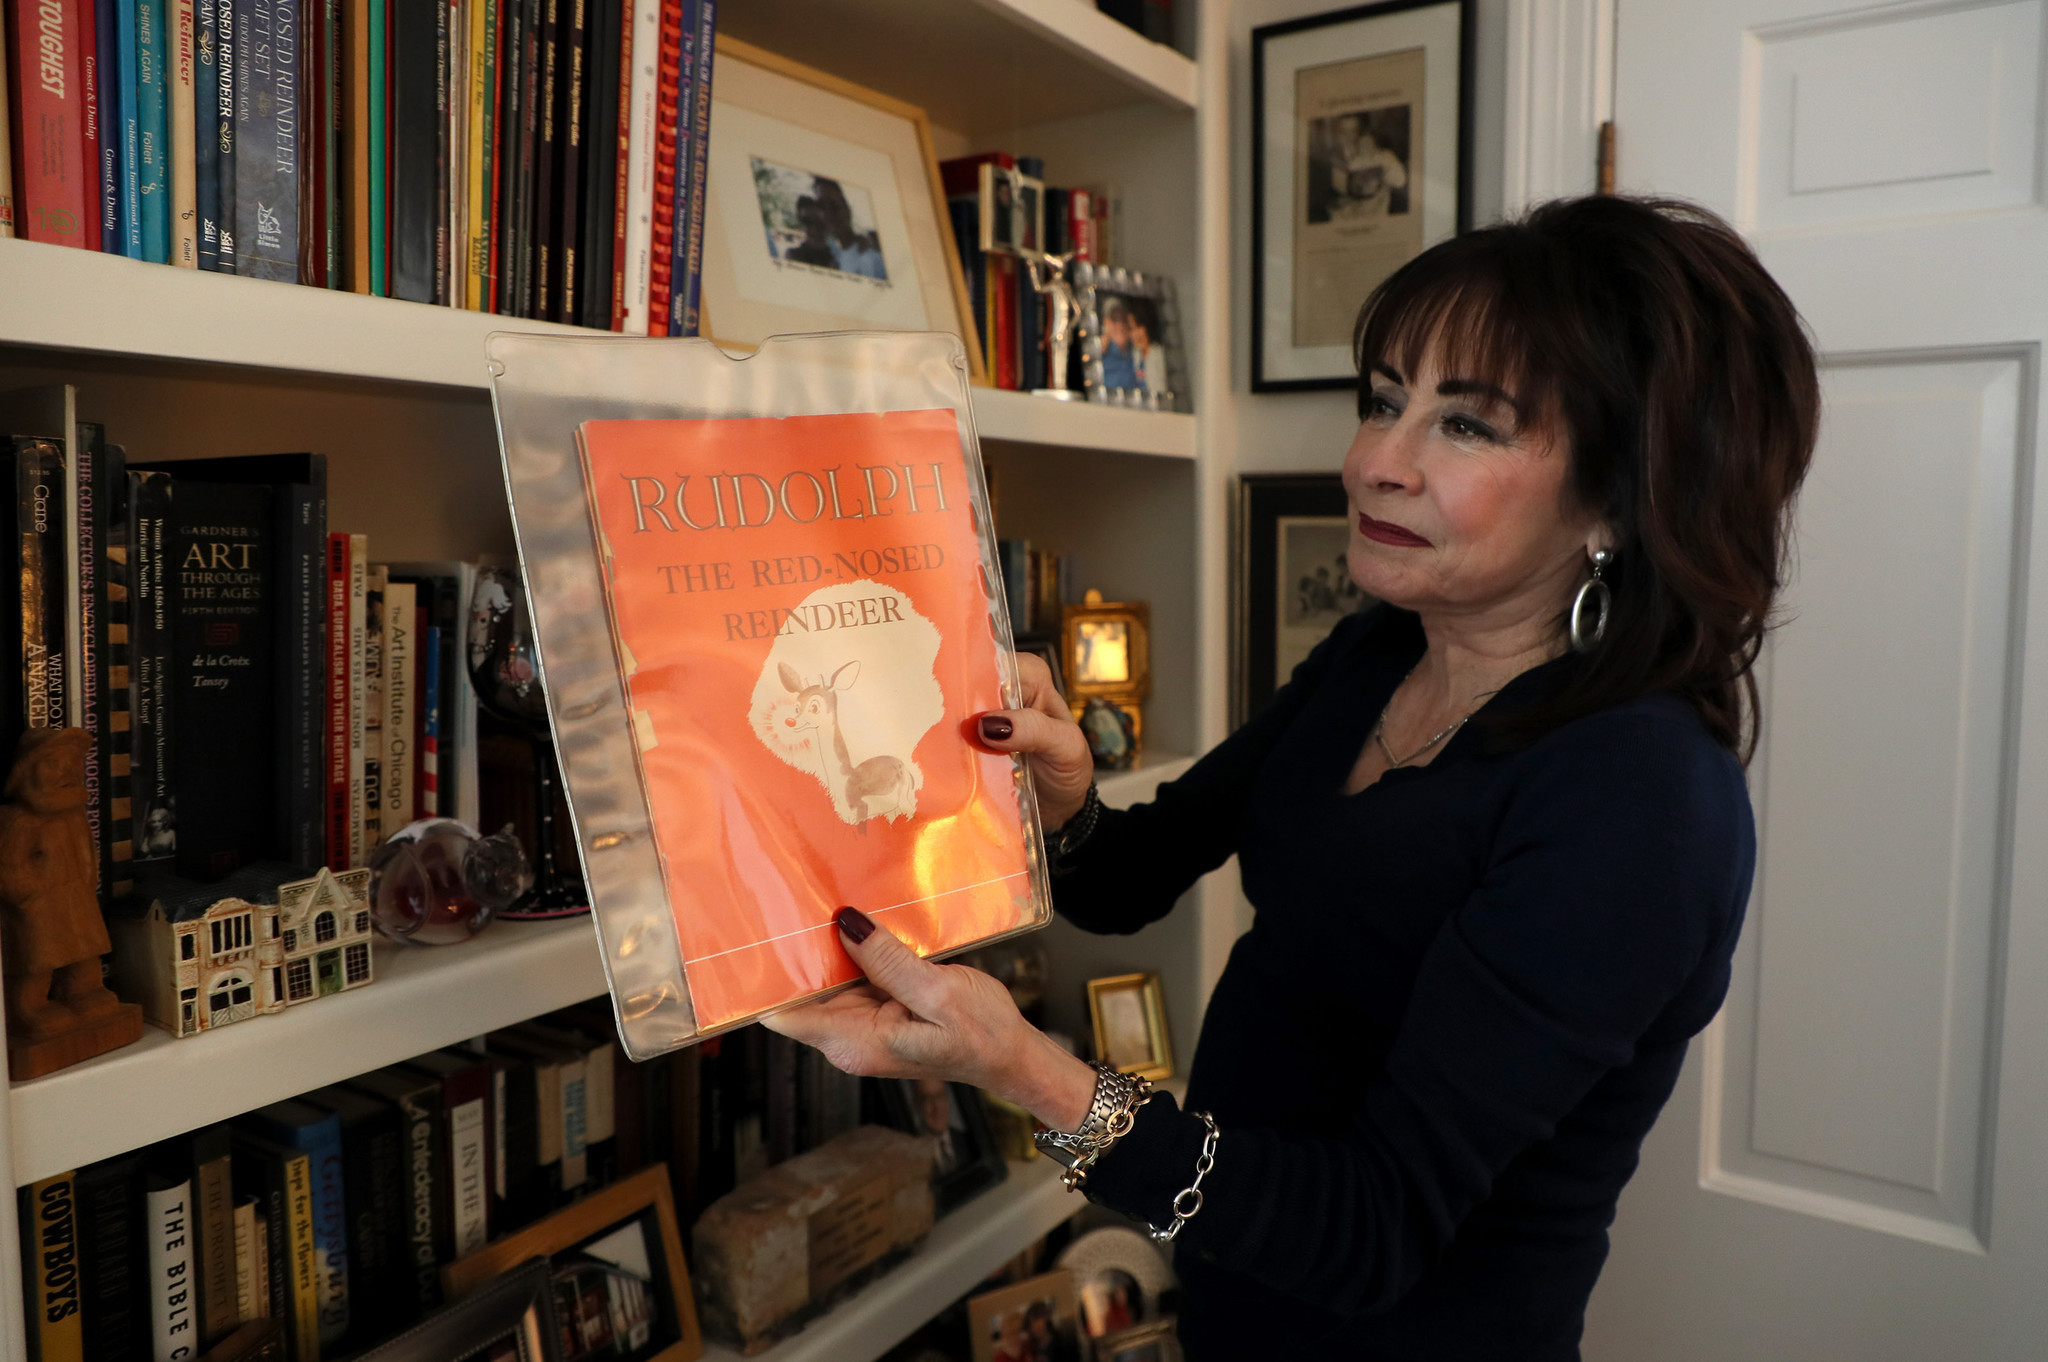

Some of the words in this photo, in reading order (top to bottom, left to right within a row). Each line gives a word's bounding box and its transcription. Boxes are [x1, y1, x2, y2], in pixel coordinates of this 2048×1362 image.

[140, 4, 151, 44] SHINES
[201, 0, 215, 28] AIN
[219, 0, 232, 39] OSED
[255, 0, 271, 41] GIFT
[38, 0, 64, 99] TOUGHEST
[180, 9, 192, 86] Reindeer
[240, 13, 249, 58] RUDOLPH
[86, 56, 95, 91] Grosset
[141, 48, 151, 84] AGAIN
[240, 59, 249, 92] SHINES
[255, 41, 271, 80] SET
[218, 42, 233, 117] REINDEER
[87, 93, 96, 102] &
[240, 93, 249, 122] AGAIN
[85, 105, 97, 140] Dunlap
[276, 68, 294, 174] REINDEER
[128, 118, 137, 169] Publications
[143, 131, 153, 163] Follett
[105, 148, 115, 182] Grosset
[107, 184, 116, 194] &
[129, 171, 139, 227] International,
[104, 196, 116, 230] Dunlap
[183, 237, 192, 261] Follett
[78, 451, 92, 482] THE
[33, 484, 50, 533] Crane
[619, 460, 951, 534] RUDOLPH
[79, 485, 95, 589] COLLECTOR'S
[139, 518, 150, 545] Harris
[154, 518, 164, 550] Women
[140, 546, 150, 562] and
[182, 542, 258, 571] ART
[657, 562, 735, 596] THE
[751, 543, 944, 587] RED-NOSED
[140, 564, 150, 598] Nochlin
[180, 572, 262, 585] THROUGH
[182, 587, 217, 599] THE
[219, 587, 262, 599] AGES
[353, 563, 363, 597] PARIS
[723, 595, 905, 642] REINDEER
[27, 641, 47, 658] A
[352, 627, 362, 657] AMIS
[391, 626, 406, 651] Art
[49, 653, 63, 693] WHAT
[140, 656, 151, 683] Alfred
[155, 656, 165, 672] Los
[192, 654, 204, 667] de
[206, 654, 217, 667] la
[218, 654, 251, 667] Croix
[352, 662, 361, 682] SES
[27, 660, 48, 729] NAKED
[153, 672, 165, 704] Angeles
[192, 675, 230, 689] Tansey
[332, 678, 344, 700] AND
[352, 688, 361, 700] ET
[391, 656, 406, 726] Institute
[49, 696, 63, 718] DO
[139, 698, 151, 725] Knopf
[153, 706, 165, 735] County
[332, 702, 345, 733] THEIR
[351, 705, 361, 748] MONET
[86, 737, 100, 806] IMOGES
[156, 736, 166, 773] Museum
[333, 734, 345, 784] HERITAGE
[156, 783, 166, 797] Art
[388, 740, 406, 810] Chicago
[351, 779, 360, 856] MARMOTTAN
[462, 1143, 479, 1168] IN
[289, 1160, 304, 1191] hope
[463, 1174, 480, 1211] THE
[208, 1175, 222, 1216] THE
[295, 1194, 307, 1215] for
[165, 1202, 185, 1251] THE
[297, 1219, 310, 1239] the
[318, 1154, 348, 1327] Gettysburg
[39, 1181, 78, 1323] COWBOYS
[211, 1218, 228, 1306] PROPHET
[298, 1242, 312, 1290] flowers
[168, 1260, 189, 1335] BIBLE
[236, 1268, 250, 1318] PROP
